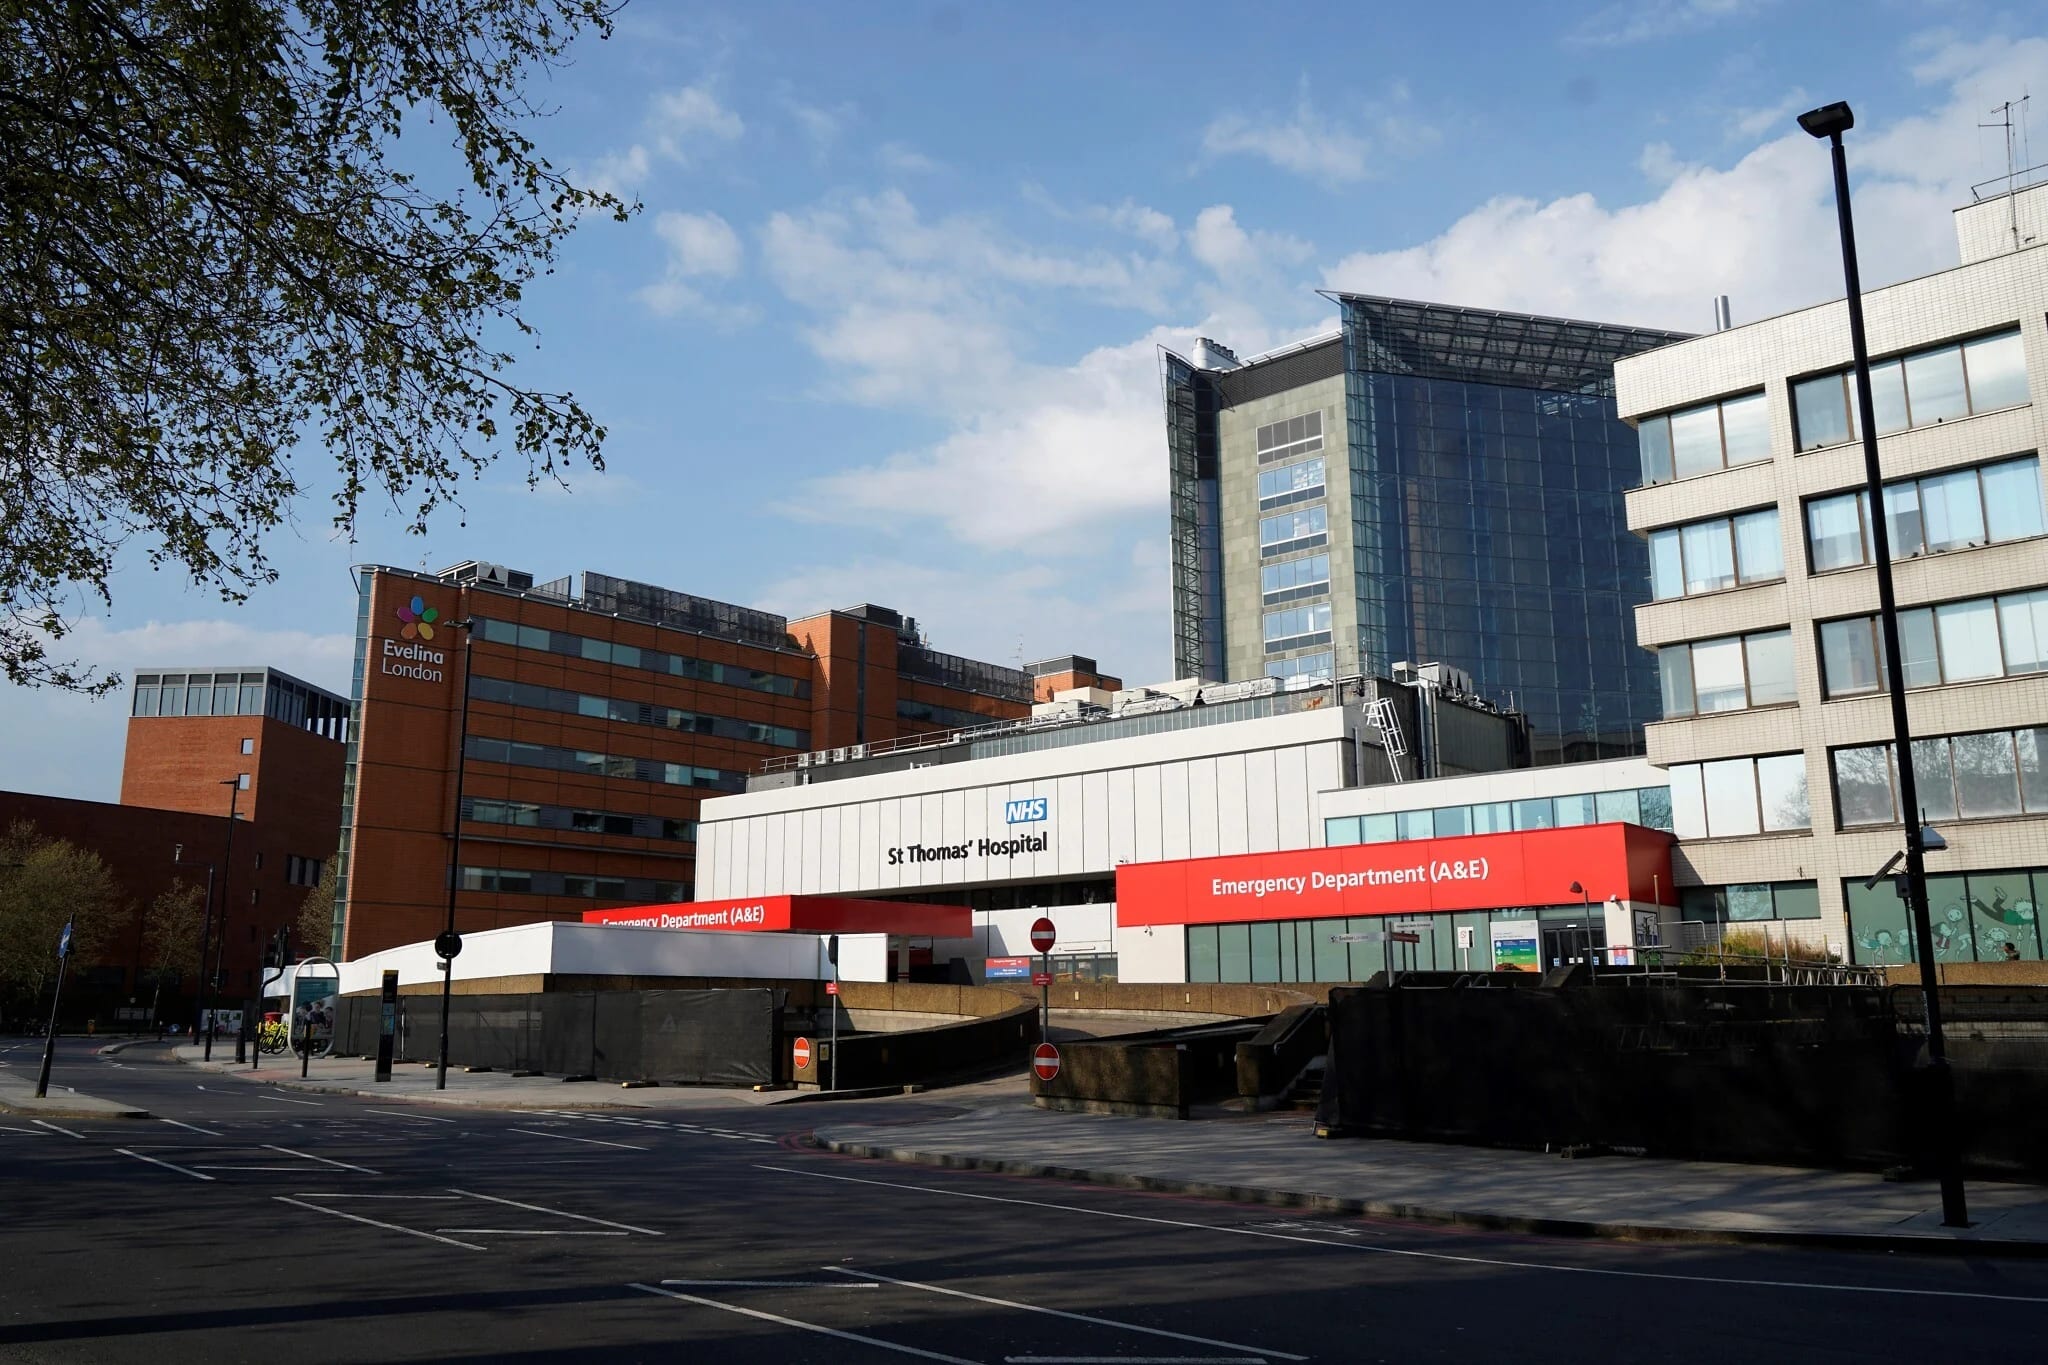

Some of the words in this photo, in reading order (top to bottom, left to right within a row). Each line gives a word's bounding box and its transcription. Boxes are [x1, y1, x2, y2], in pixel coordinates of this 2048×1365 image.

[383, 638, 445, 665] Evelina
[382, 656, 443, 682] London
[1006, 799, 1046, 823] NHS
[887, 847, 904, 865] St
[978, 831, 1048, 859] Hospital
[1211, 875, 1306, 897] Emergency
[1311, 865, 1426, 891] Department
[1429, 857, 1489, 882] (A&E)
[661, 909, 728, 929] Department
[730, 905, 764, 926] (A&E)
